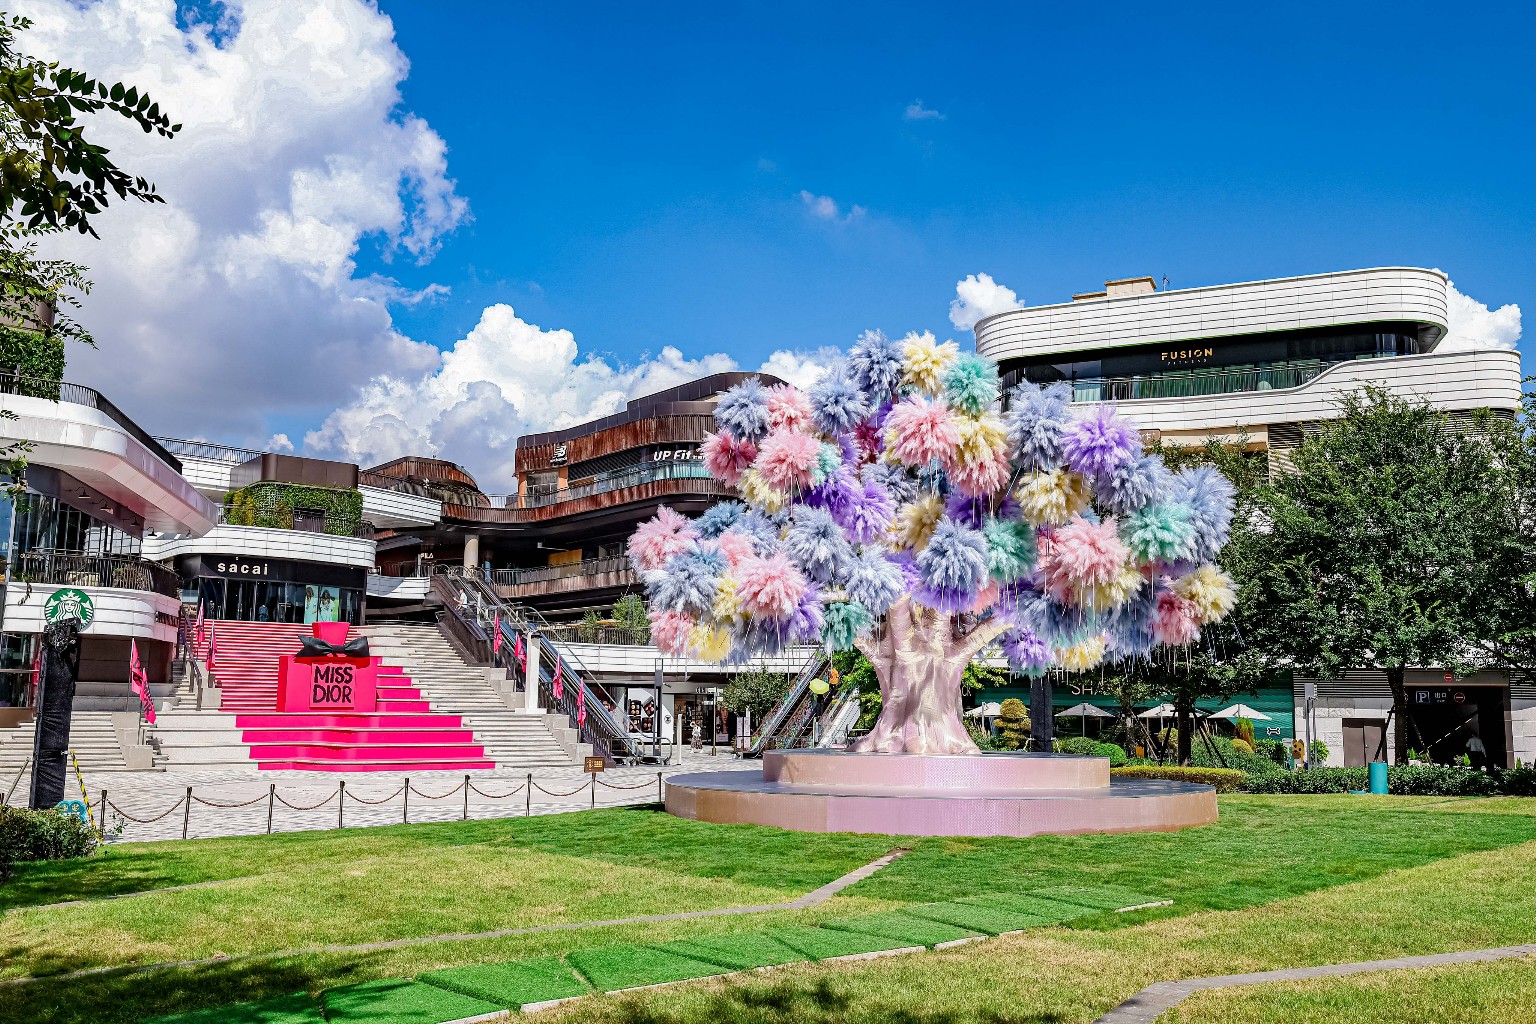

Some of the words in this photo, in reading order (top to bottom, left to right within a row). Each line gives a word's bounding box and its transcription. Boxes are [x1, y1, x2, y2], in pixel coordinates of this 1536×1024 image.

[1161, 347, 1213, 361] FUSION
[653, 450, 671, 461] UP
[673, 449, 691, 460] Fit
[217, 562, 268, 576] sacai
[313, 665, 353, 684] MISS
[312, 684, 352, 704] DIOR
